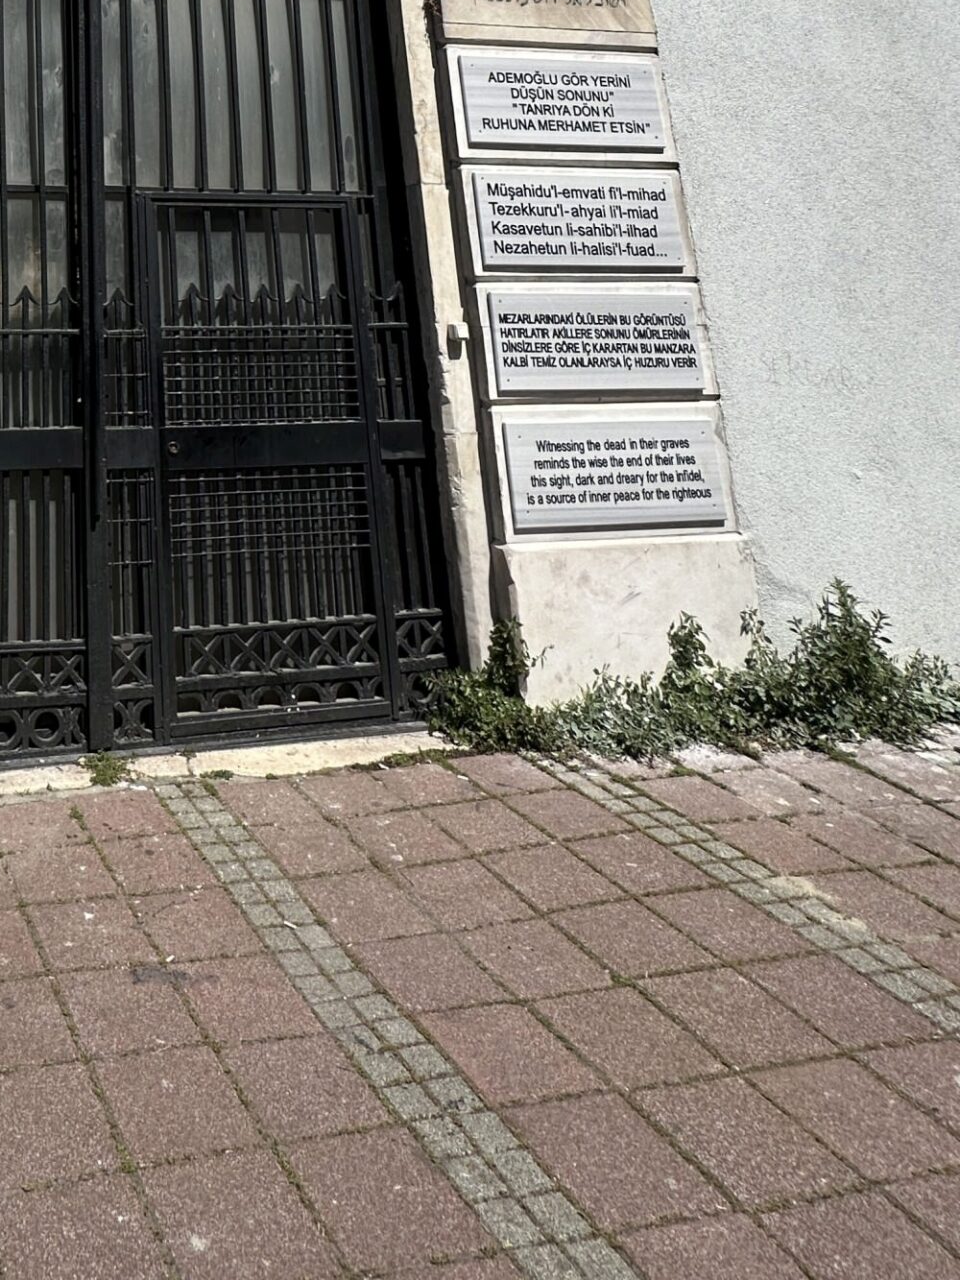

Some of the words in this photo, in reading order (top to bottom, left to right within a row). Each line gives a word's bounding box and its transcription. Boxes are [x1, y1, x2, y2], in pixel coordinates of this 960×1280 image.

[488, 70, 558, 85] ADEMOĞLU
[561, 73, 589, 86] GÖR
[591, 74, 631, 88] YERİNİ
[511, 87, 554, 102] DÜŞÜN
[573, 103, 599, 117] DÖN
[603, 104, 615, 117] Kİ
[482, 118, 536, 130] RUHUNA
[539, 120, 607, 132] MERHAMET
[492, 222, 563, 236] Kasavetun
[494, 241, 567, 255] Nezahetun
[499, 312, 574, 325] MEZARLARINDAKİ
[576, 312, 617, 325] ÖLÜLERİN
[620, 315, 631, 325] BU
[634, 313, 686, 326] GÖRÜNTÜSÜ
[500, 328, 549, 338] HATIRLATIR
[595, 328, 631, 339] SONUNU
[502, 342, 552, 353] DİNSİZLERE
[555, 342, 580, 353] GÖRE
[582, 342, 591, 355] İÇ
[593, 343, 638, 353] KARARTAN
[640, 344, 652, 354] BU
[654, 344, 696, 354] MANZARA
[503, 355, 528, 367] KALBİ
[531, 355, 557, 367] TEMİZ
[560, 357, 621, 368] OLANLARAYSA
[624, 356, 632, 370] İÇ
[634, 357, 669, 368] HUZURU
[671, 355, 697, 368] VERİR
[536, 440, 584, 454] Witnessing
[587, 439, 601, 451] the
[604, 439, 626, 451] dead
[630, 438, 637, 450] in
[640, 438, 658, 449] their
[661, 439, 689, 451] graves
[534, 458, 569, 469] reminds
[572, 457, 586, 468] the
[588, 456, 608, 467] wise
[610, 455, 624, 467] the
[627, 455, 642, 466] end
[645, 454, 653, 465] of
[655, 454, 673, 465] their
[676, 453, 696, 465] lives
[531, 476, 547, 487] this
[550, 474, 573, 489] sight,
[576, 474, 594, 485] dark
[598, 473, 614, 484] and
[617, 472, 644, 486] dreary
[647, 471, 658, 482] for
[660, 471, 674, 482] the
[527, 493, 535, 505] is
[538, 496, 543, 504] a
[546, 493, 576, 503] source
[579, 491, 587, 502] of
[589, 490, 611, 502] inner
[614, 491, 640, 504] peace
[642, 489, 653, 500] for
[656, 488, 670, 500] the
[672, 488, 711, 501] righteous
